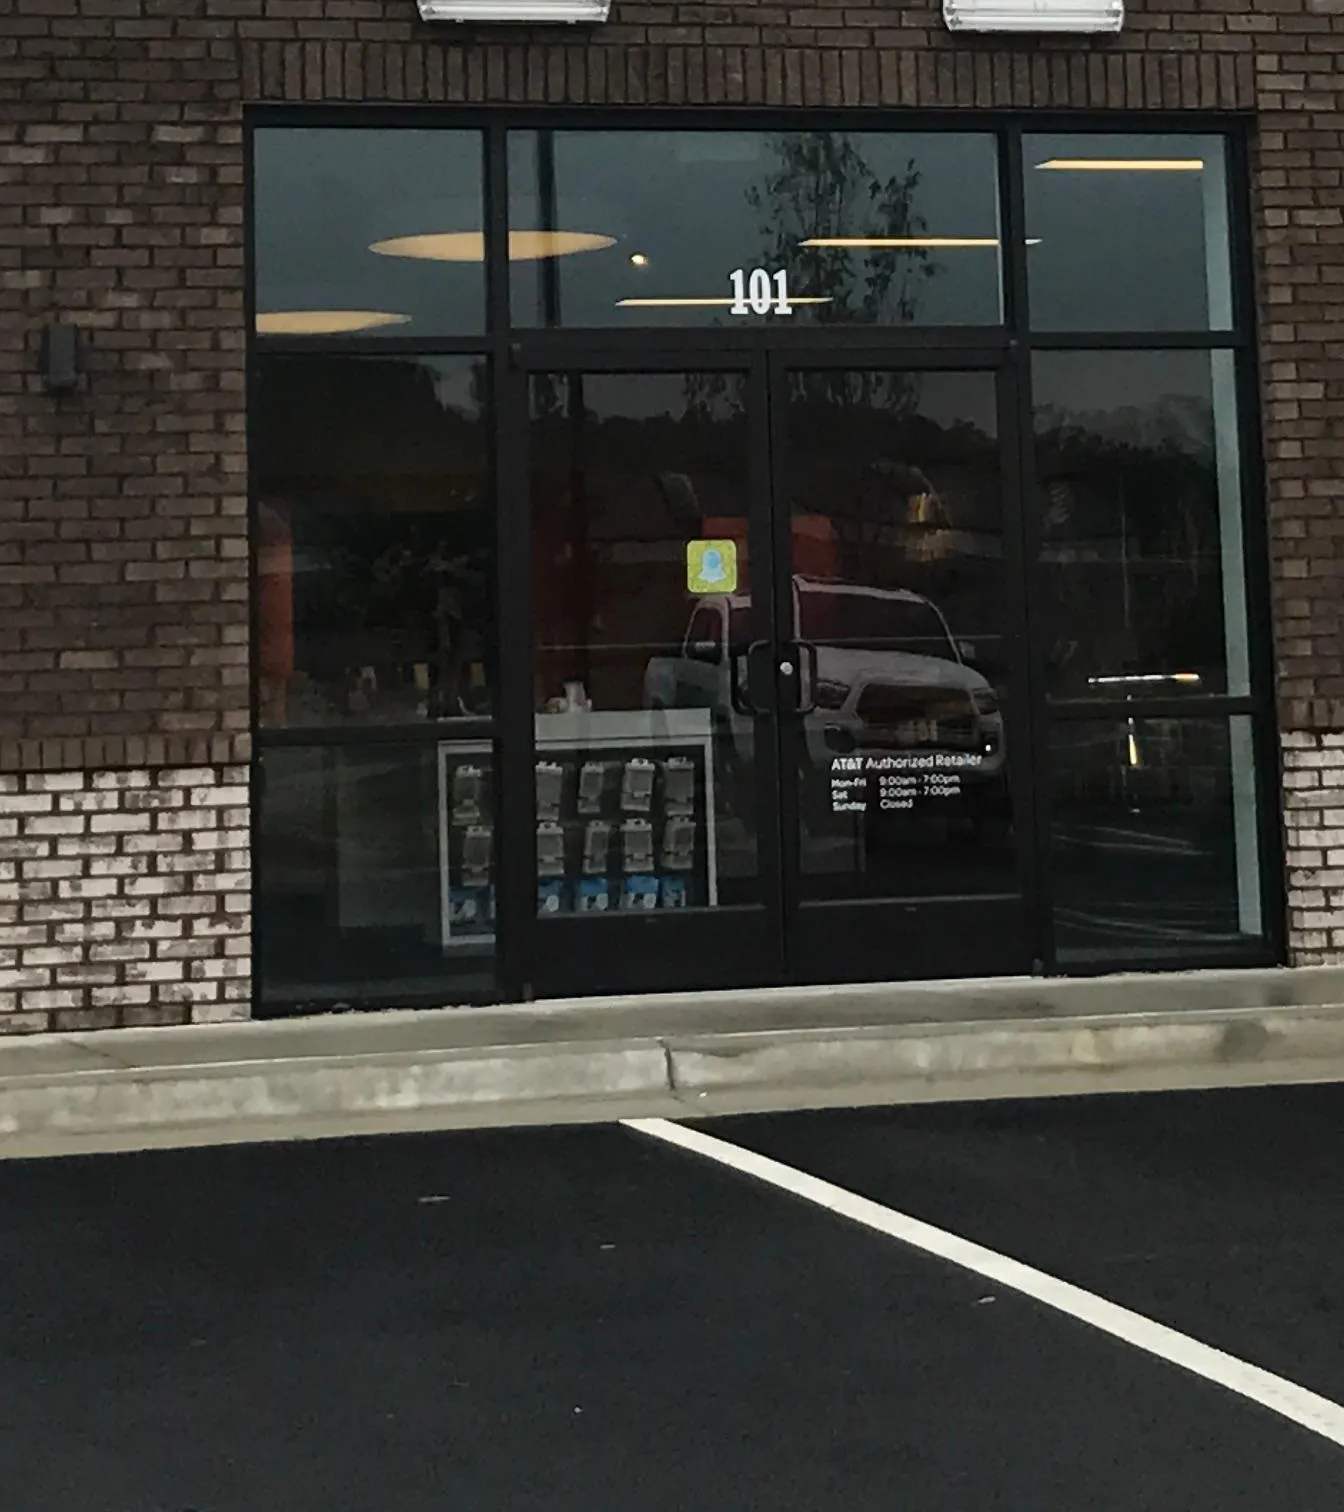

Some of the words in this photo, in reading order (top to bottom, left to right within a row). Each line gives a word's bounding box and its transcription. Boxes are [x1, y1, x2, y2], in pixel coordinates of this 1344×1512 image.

[729, 268, 793, 315] 101
[831, 757, 864, 770] AT&T
[865, 756, 935, 769] Authorized
[935, 753, 983, 767] Retailer
[832, 801, 867, 812] Sunday
[879, 799, 914, 809] Closed
